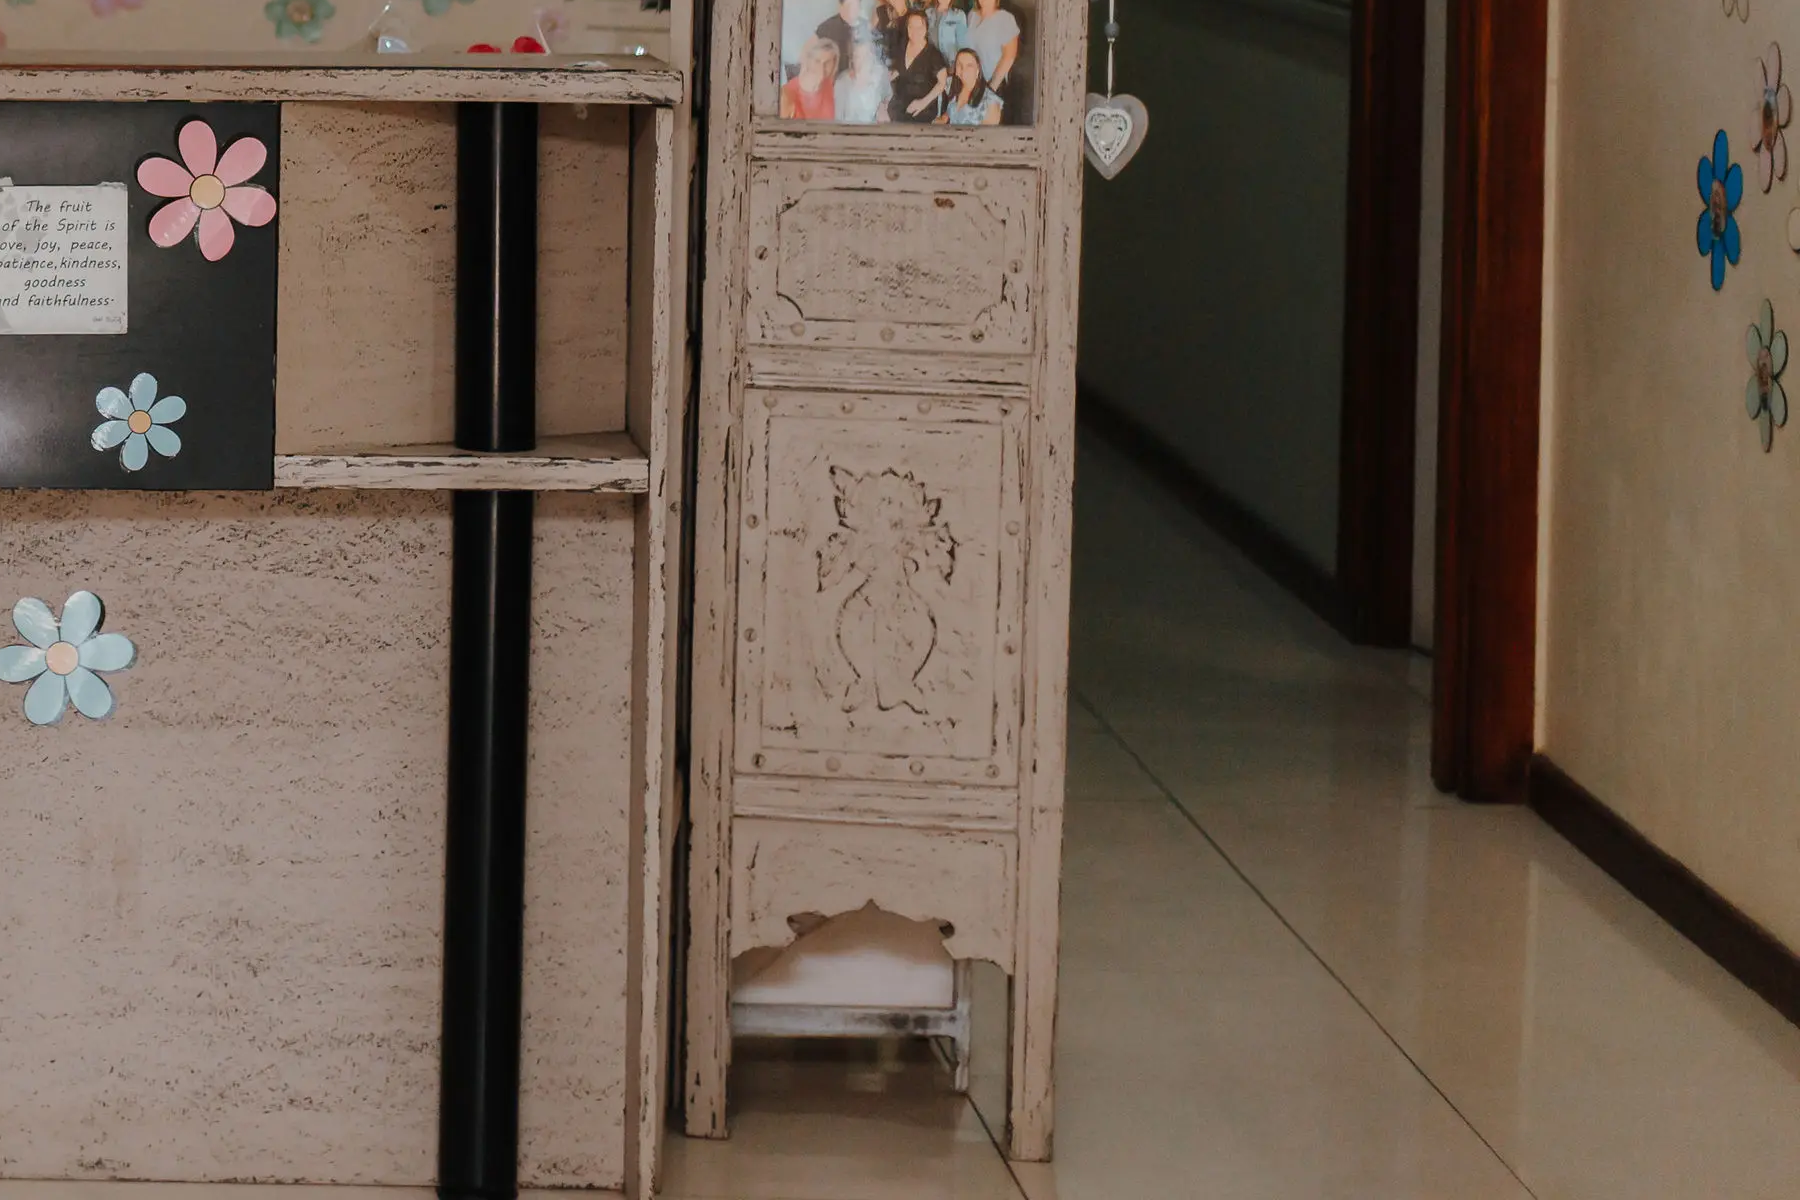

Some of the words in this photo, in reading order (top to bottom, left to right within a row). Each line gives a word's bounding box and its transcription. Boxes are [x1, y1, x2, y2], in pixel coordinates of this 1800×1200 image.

[26, 200, 51, 213] The
[59, 200, 93, 213] fruit
[2, 219, 20, 231] of
[25, 219, 49, 231] the
[56, 218, 97, 234] Spirit
[105, 220, 116, 231] is
[34, 240, 61, 253] joy,
[70, 240, 112, 252] peace,
[60, 256, 121, 270] kindness,
[24, 275, 86, 291] goodness
